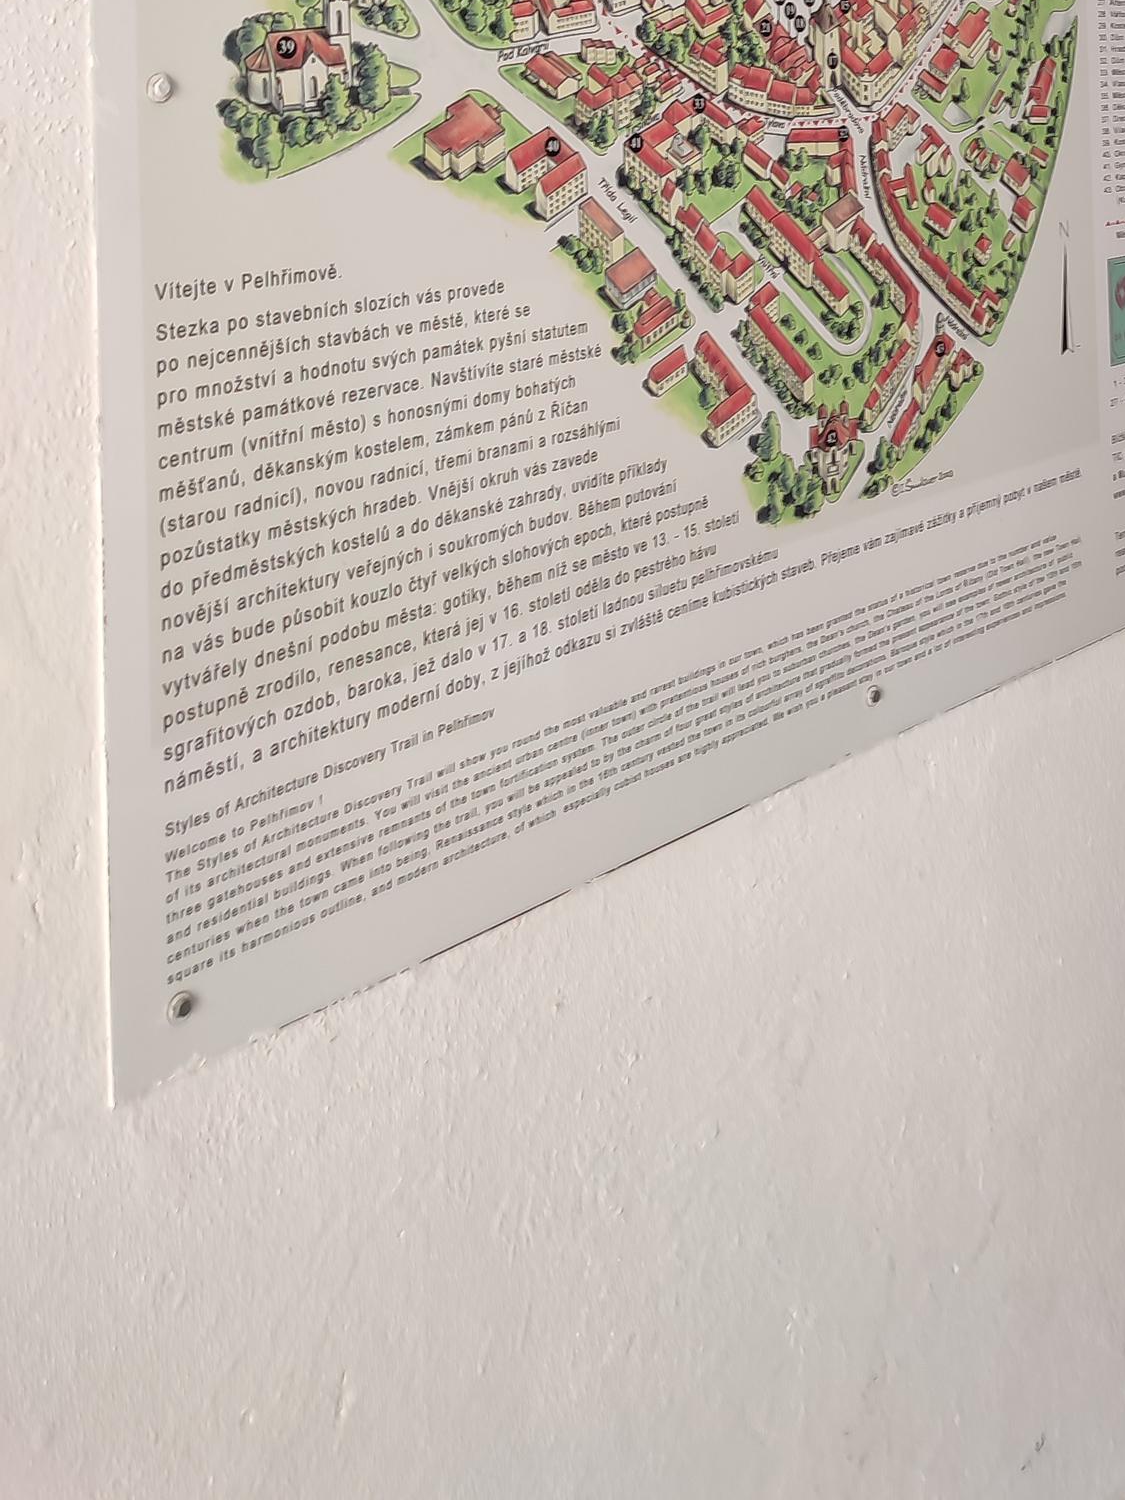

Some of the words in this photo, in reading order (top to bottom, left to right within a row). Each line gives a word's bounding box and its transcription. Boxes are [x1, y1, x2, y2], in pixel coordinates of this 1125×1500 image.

[153, 278, 217, 302] Vítejte
[223, 278, 235, 293] v
[241, 262, 343, 291] Pelhřimově.
[155, 318, 220, 342] Stezka
[227, 316, 249, 336] po
[255, 299, 349, 328] stavebních
[353, 290, 411, 314] slozích
[415, 287, 442, 305] vás
[447, 278, 505, 304] provede
[155, 357, 180, 379] po
[186, 334, 311, 371] nejcennějších
[317, 322, 390, 349] stavbách
[395, 322, 414, 337] ve
[418, 311, 468, 333] městě,
[473, 304, 510, 325] které
[514, 304, 531, 319] se
[156, 387, 188, 411] pro
[195, 368, 276, 400] množství
[282, 370, 293, 385] a
[299, 356, 367, 382] hodnotu
[371, 347, 417, 371] svých
[421, 336, 484, 365] památek
[489, 328, 527, 354] pyšní
[530, 322, 589, 343] statutem
[157, 407, 236, 439] městské
[242, 389, 336, 427] památkové
[341, 378, 425, 405] rezervace.
[430, 361, 505, 388] Navštívíte
[508, 352, 544, 374] staré
[548, 343, 602, 366] městské
[157, 442, 234, 471] centrum
[241, 424, 304, 458] (vnitřní
[310, 413, 367, 440] město)
[372, 414, 382, 428] s
[387, 393, 468, 425] honosnými
[472, 388, 511, 408] domy
[515, 374, 577, 400] bohatých
[158, 468, 246, 503] měšťanů,
[253, 449, 349, 482] děkanským
[354, 434, 430, 461] kostelem,
[434, 419, 495, 444] zámkem
[499, 407, 534, 434] pánů
[537, 409, 547, 422] z
[550, 399, 589, 420] Říčan
[159, 506, 227, 539] (starou
[234, 486, 308, 518] radnicí),
[314, 475, 365, 499] novou
[370, 458, 429, 486] radnicí,
[434, 448, 473, 472] třemi
[477, 435, 534, 463] branami
[537, 435, 547, 449] a
[551, 415, 621, 446] rozsáhlými
[159, 529, 261, 572] pozůstatky
[267, 504, 357, 541] městských
[362, 490, 422, 518] hradeb.
[427, 475, 475, 502] Vnější
[479, 466, 520, 490] okruh
[523, 461, 548, 479] vás
[551, 448, 599, 473] zavede
[159, 579, 184, 600] do
[191, 542, 326, 596] předměstských
[331, 524, 390, 555] kostelů
[395, 524, 406, 539] a
[410, 517, 430, 535] do
[434, 496, 504, 529] děkanské
[571, 471, 615, 494] uvidíte
[618, 457, 668, 485] příklady
[160, 596, 229, 633] novější
[236, 570, 341, 612] architektury
[345, 546, 424, 581] veřejných
[438, 519, 524, 557] soukromých
[577, 496, 621, 519] Během
[624, 477, 678, 509] putování
[161, 645, 185, 665] na
[191, 632, 225, 655] vás
[231, 618, 276, 645] bude
[350, 582, 403, 610] kouzlo
[442, 554, 498, 583] velkých
[501, 534, 570, 567] slohových
[620, 510, 653, 533] které
[161, 657, 248, 699] vytvářely
[254, 634, 313, 669] dnešní
[319, 619, 380, 653] podobu
[496, 571, 543, 596] během
[571, 558, 588, 573] se
[591, 545, 630, 567] město
[632, 540, 649, 555] ve
[162, 685, 249, 734] postupně
[422, 620, 462, 647] která
[464, 612, 485, 638] jej
[488, 611, 498, 626] v
[528, 585, 571, 613] století
[575, 576, 611, 599] oděla
[614, 570, 631, 586] do
[164, 811, 211, 838] Styles
[215, 800, 231, 820] of
[233, 771, 319, 813] Architecture
[322, 747, 387, 780] Discovery
[389, 732, 419, 754] Trail
[164, 832, 227, 864] Welcome
